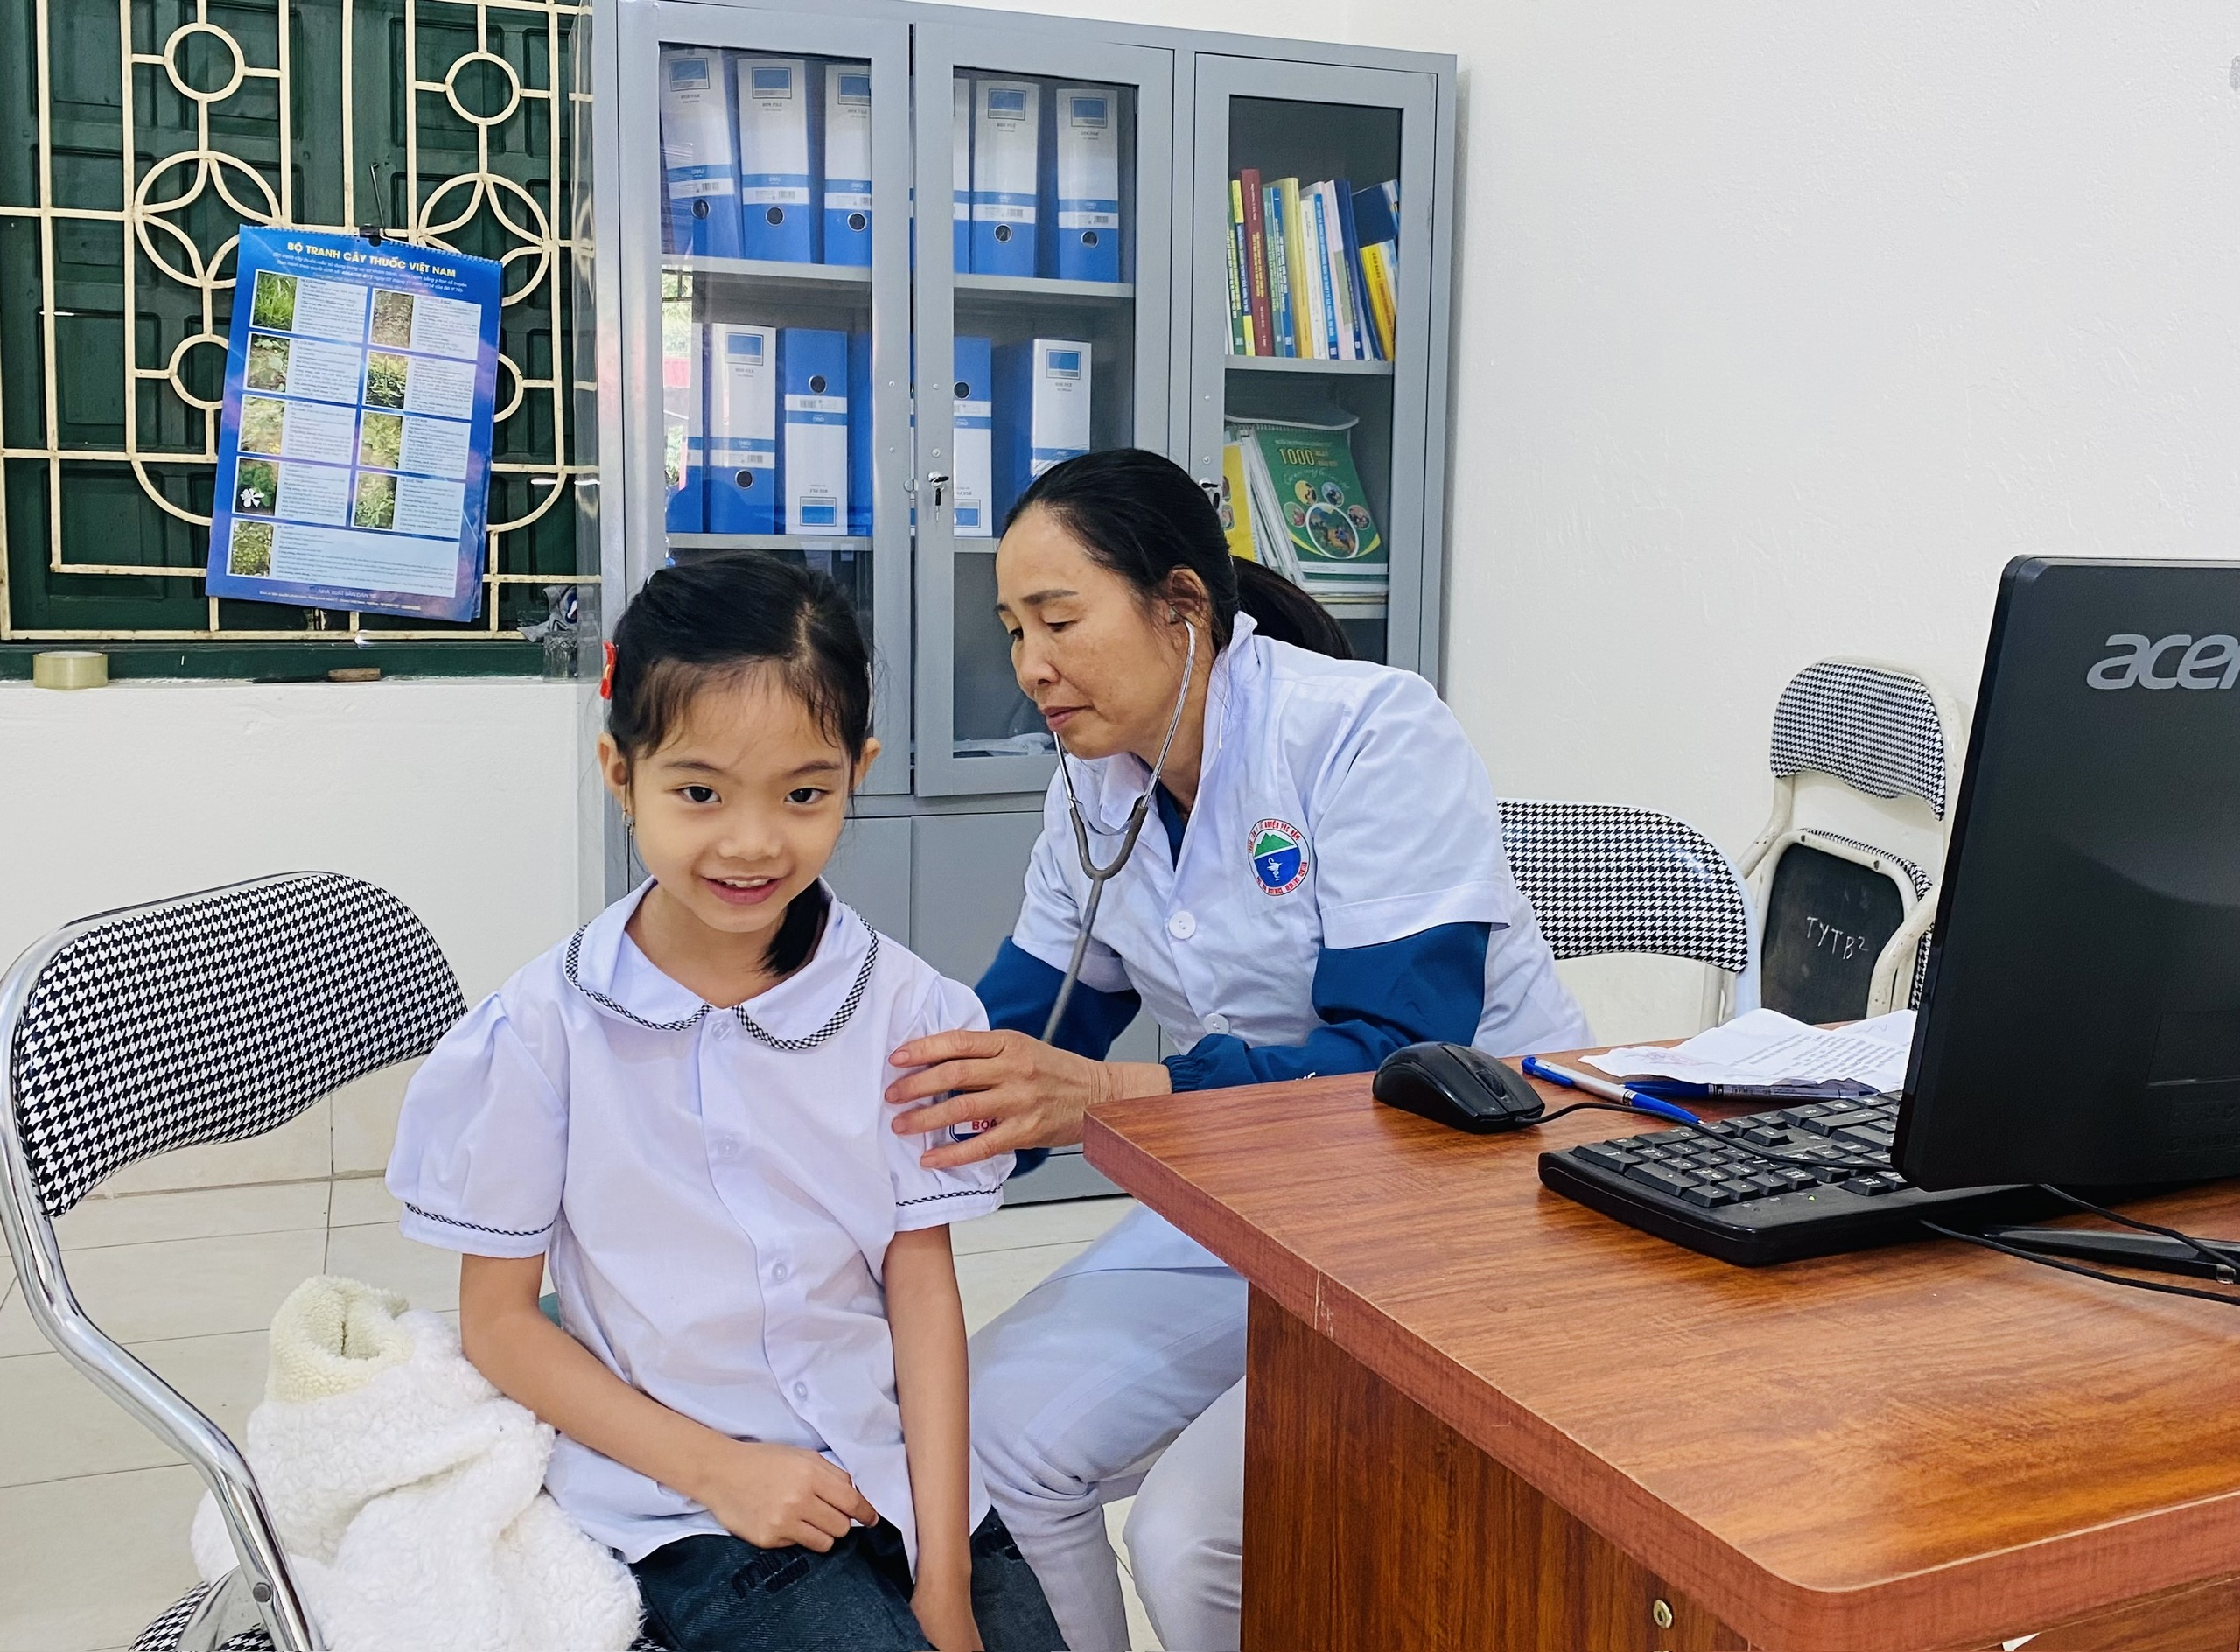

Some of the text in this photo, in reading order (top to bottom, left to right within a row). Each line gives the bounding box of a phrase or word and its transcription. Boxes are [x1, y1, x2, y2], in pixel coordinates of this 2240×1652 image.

[286, 240, 456, 277] BỘ TRANH CÂY THUỐC VIỆT NAM
[1279, 448, 1315, 466] 1000
